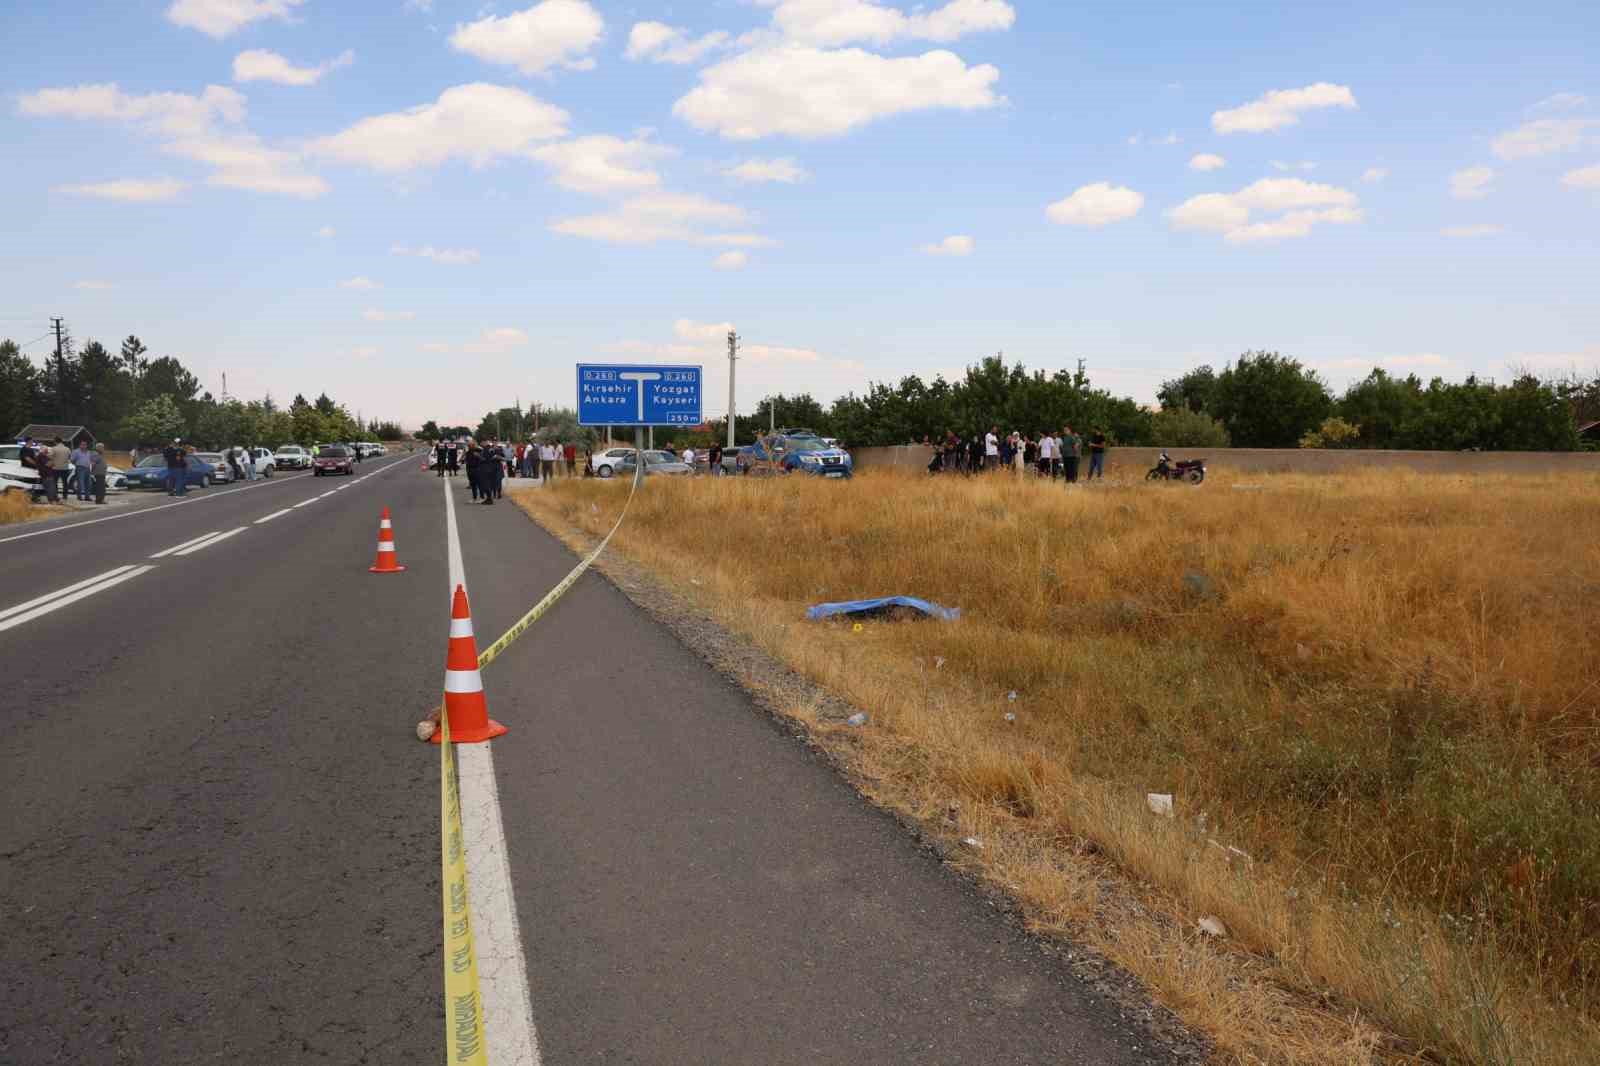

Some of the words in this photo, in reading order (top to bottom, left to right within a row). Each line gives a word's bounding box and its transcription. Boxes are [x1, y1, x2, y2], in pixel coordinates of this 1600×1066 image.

[654, 384, 694, 395] Yozgat
[584, 394, 626, 404] Ankara
[653, 395, 697, 405] Kayseri
